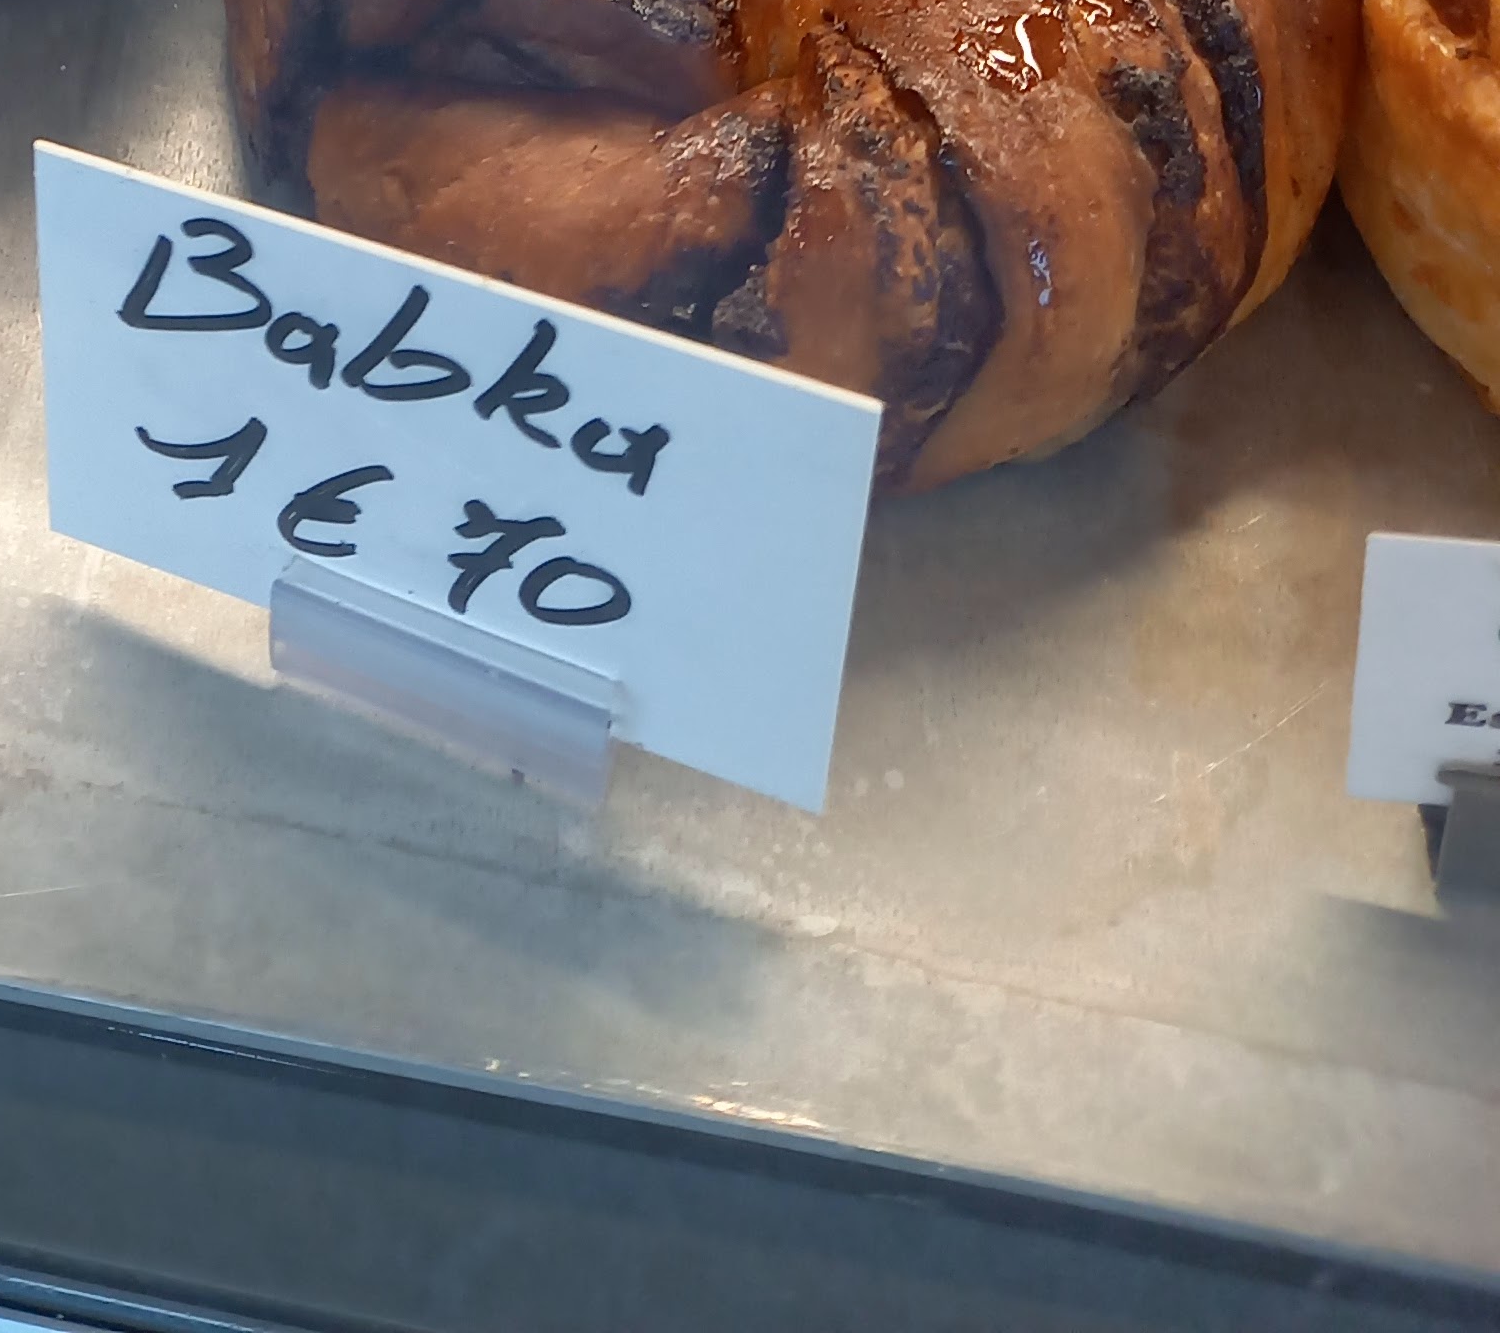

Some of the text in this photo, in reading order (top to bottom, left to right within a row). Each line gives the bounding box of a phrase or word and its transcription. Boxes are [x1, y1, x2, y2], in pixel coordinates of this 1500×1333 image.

[117, 218, 670, 495] Babka
[135, 417, 631, 626] 1 € 70
